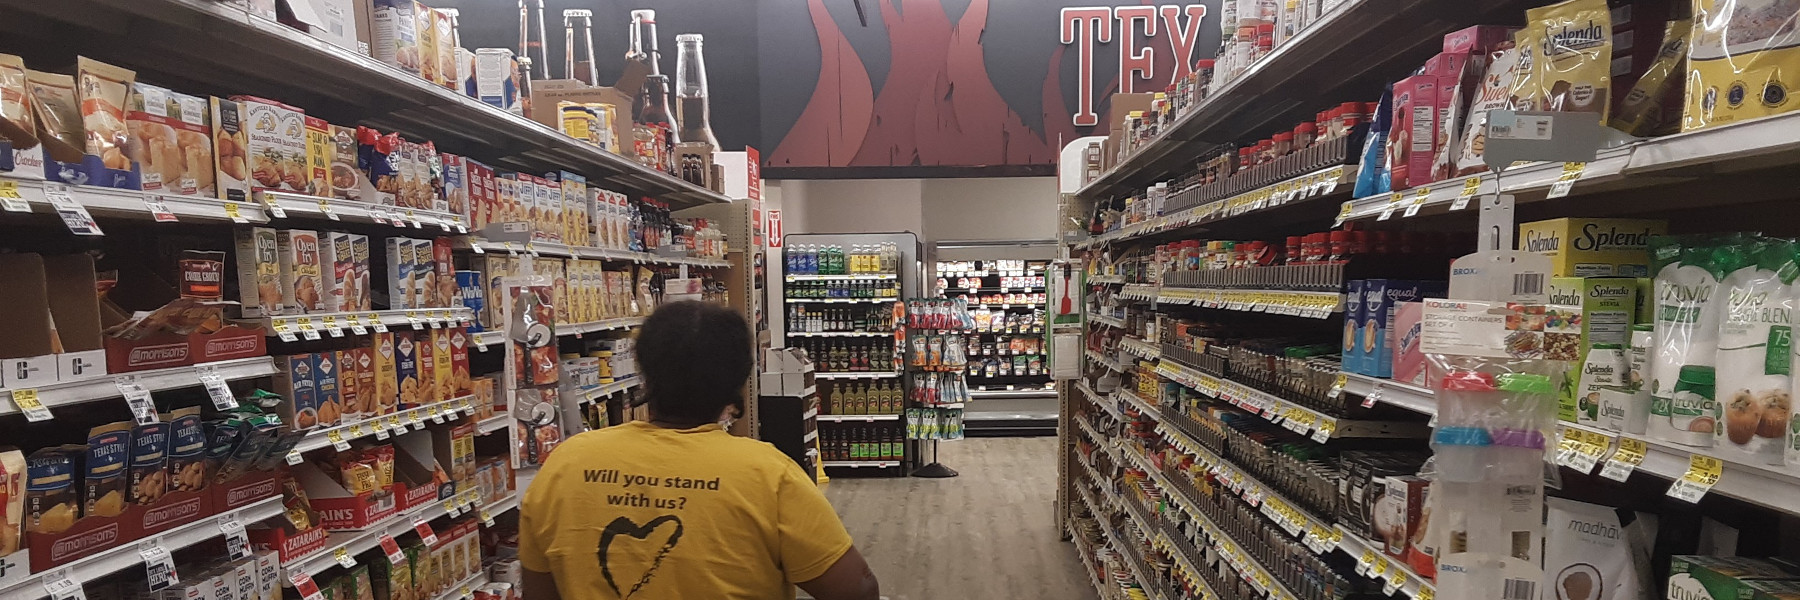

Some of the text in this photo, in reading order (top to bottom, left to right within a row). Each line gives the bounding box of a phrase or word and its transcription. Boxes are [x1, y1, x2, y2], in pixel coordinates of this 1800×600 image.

[1544, 20, 1602, 56] Splenda
[258, 236, 275, 251] Oven
[296, 238, 315, 252] Oven
[1523, 229, 1560, 253] Splenda
[263, 249, 274, 262] fry
[302, 251, 313, 266] fry
[1386, 286, 1418, 299] equal
[1590, 284, 1630, 298] Splenda
[1426, 301, 1467, 310] KOLORAE
[1458, 315, 1503, 323] CONTAINERS
[1762, 307, 1792, 324] BLEN
[1775, 329, 1791, 347] 75
[1585, 362, 1614, 375] Splenda
[1587, 383, 1600, 392] ZER
[93, 445, 109, 458] TEXAS
[583, 469, 720, 491] Will you stand
[607, 493, 687, 510] with us?
[261, 565, 274, 576] CORN
[57, 579, 73, 589] 1.19
[215, 585, 230, 598] CORN
